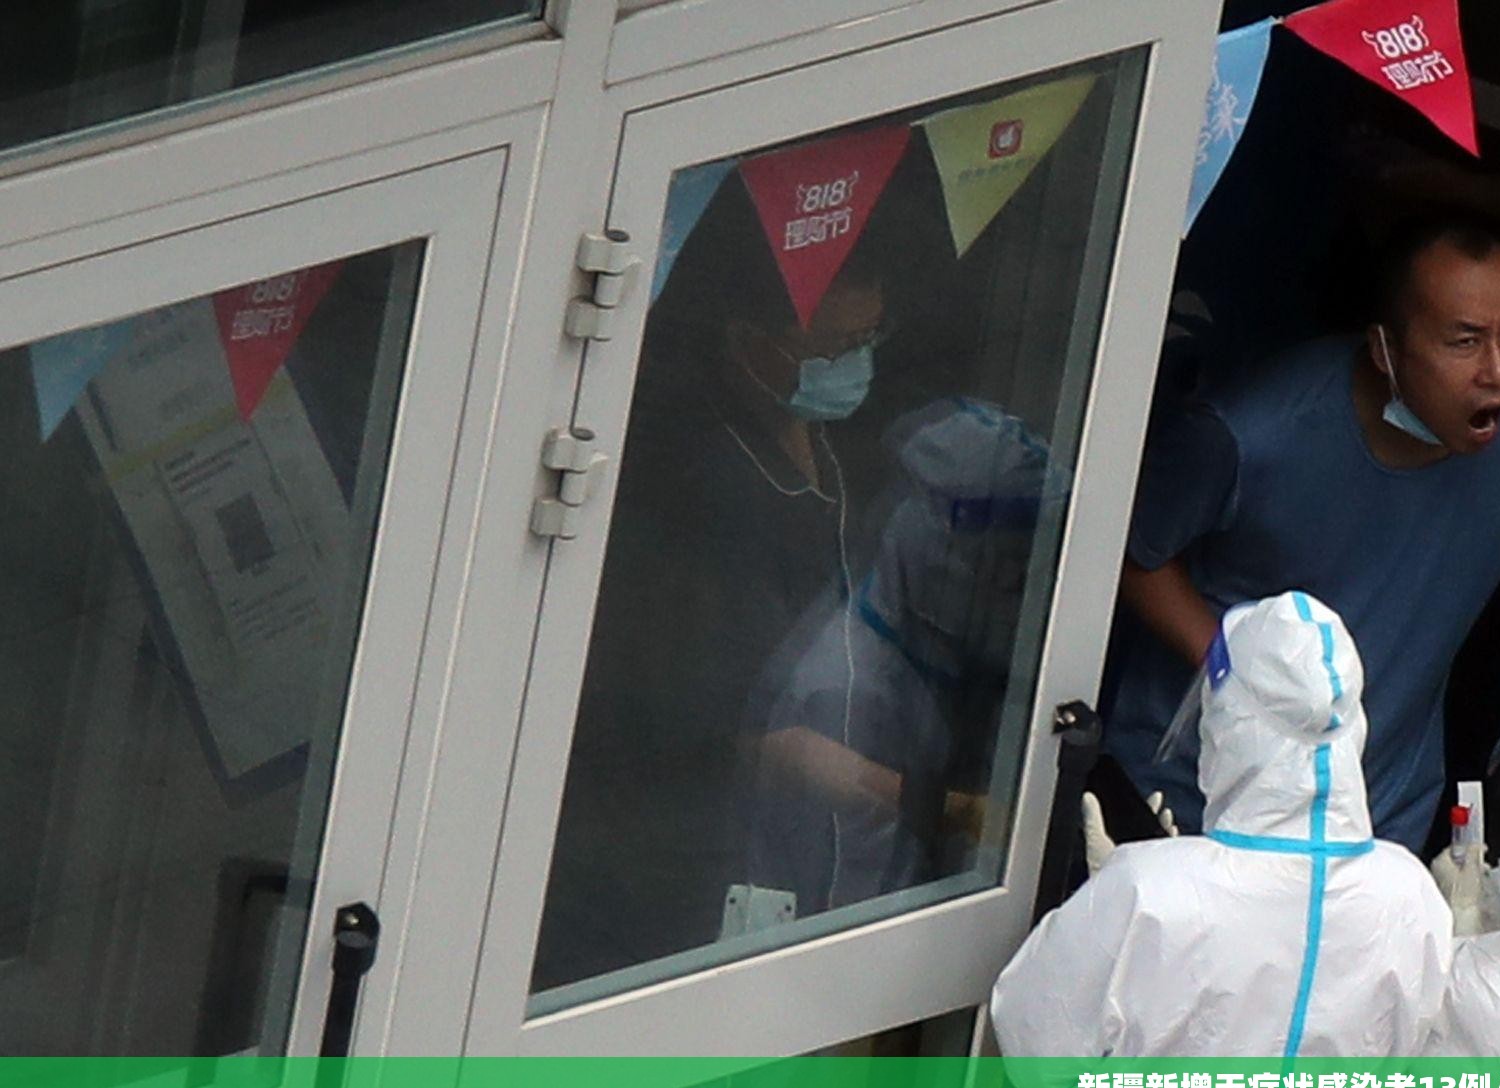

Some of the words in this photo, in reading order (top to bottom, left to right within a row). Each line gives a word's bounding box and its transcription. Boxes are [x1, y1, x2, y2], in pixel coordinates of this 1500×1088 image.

[1375, 23, 1423, 57] 818
[1381, 50, 1454, 90] 理财节
[802, 179, 847, 213] 818
